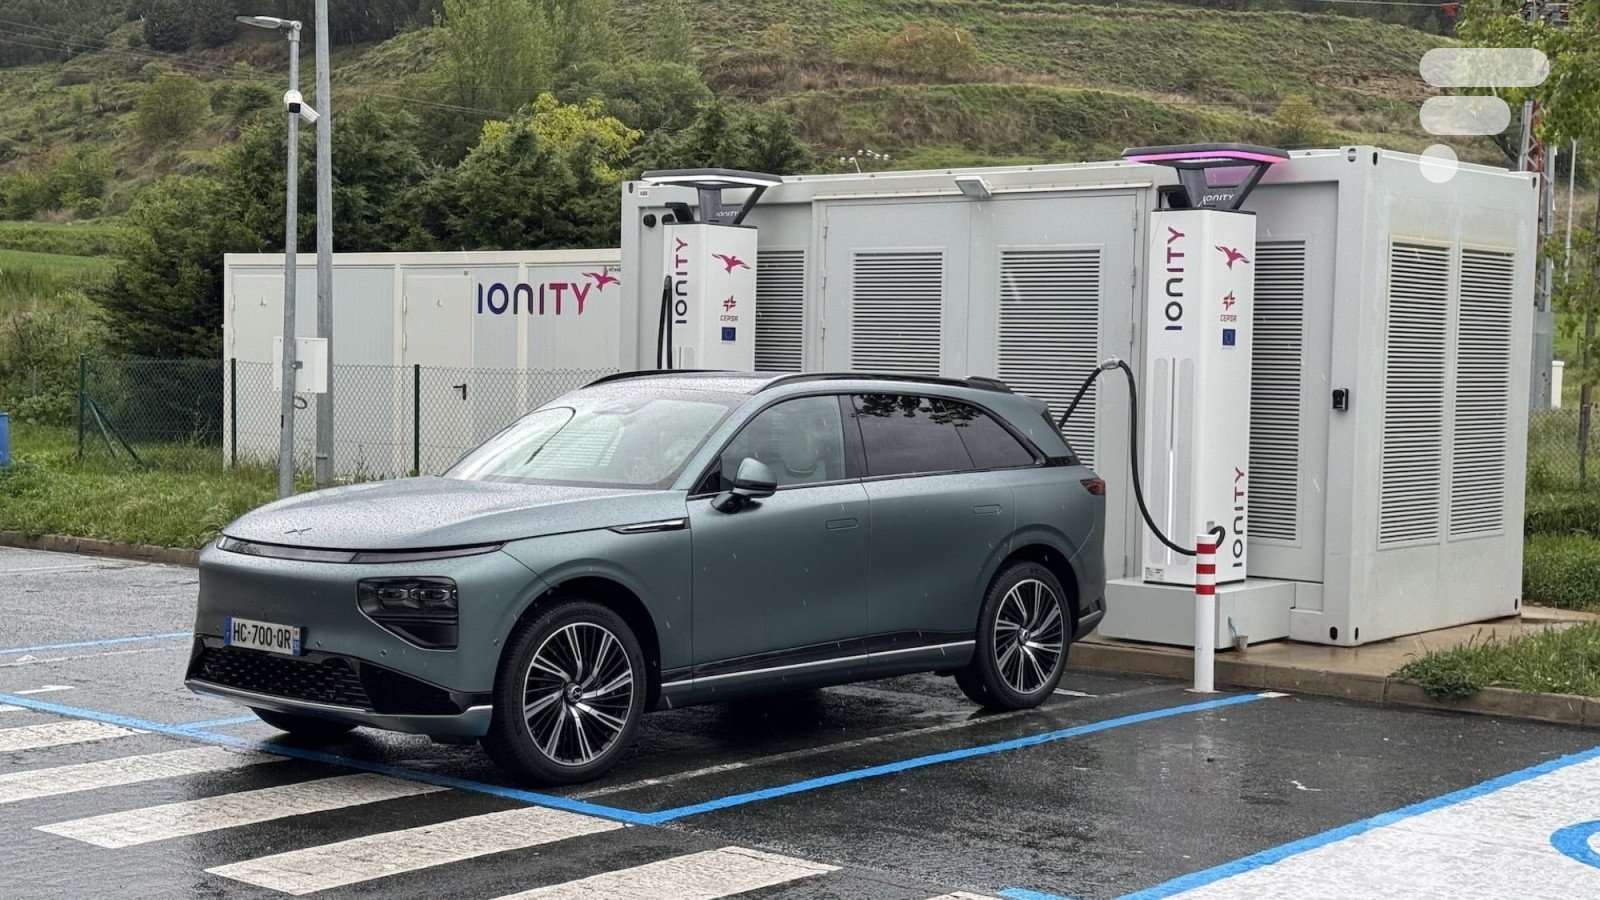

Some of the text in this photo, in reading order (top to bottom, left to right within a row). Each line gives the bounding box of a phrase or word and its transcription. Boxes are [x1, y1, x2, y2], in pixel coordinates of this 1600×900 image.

[1202, 194, 1235, 203] IONITY
[478, 283, 592, 315] IONITY
[675, 237, 688, 324] IONITY
[1165, 226, 1185, 331] IONITY
[1232, 467, 1245, 568] IONITY
